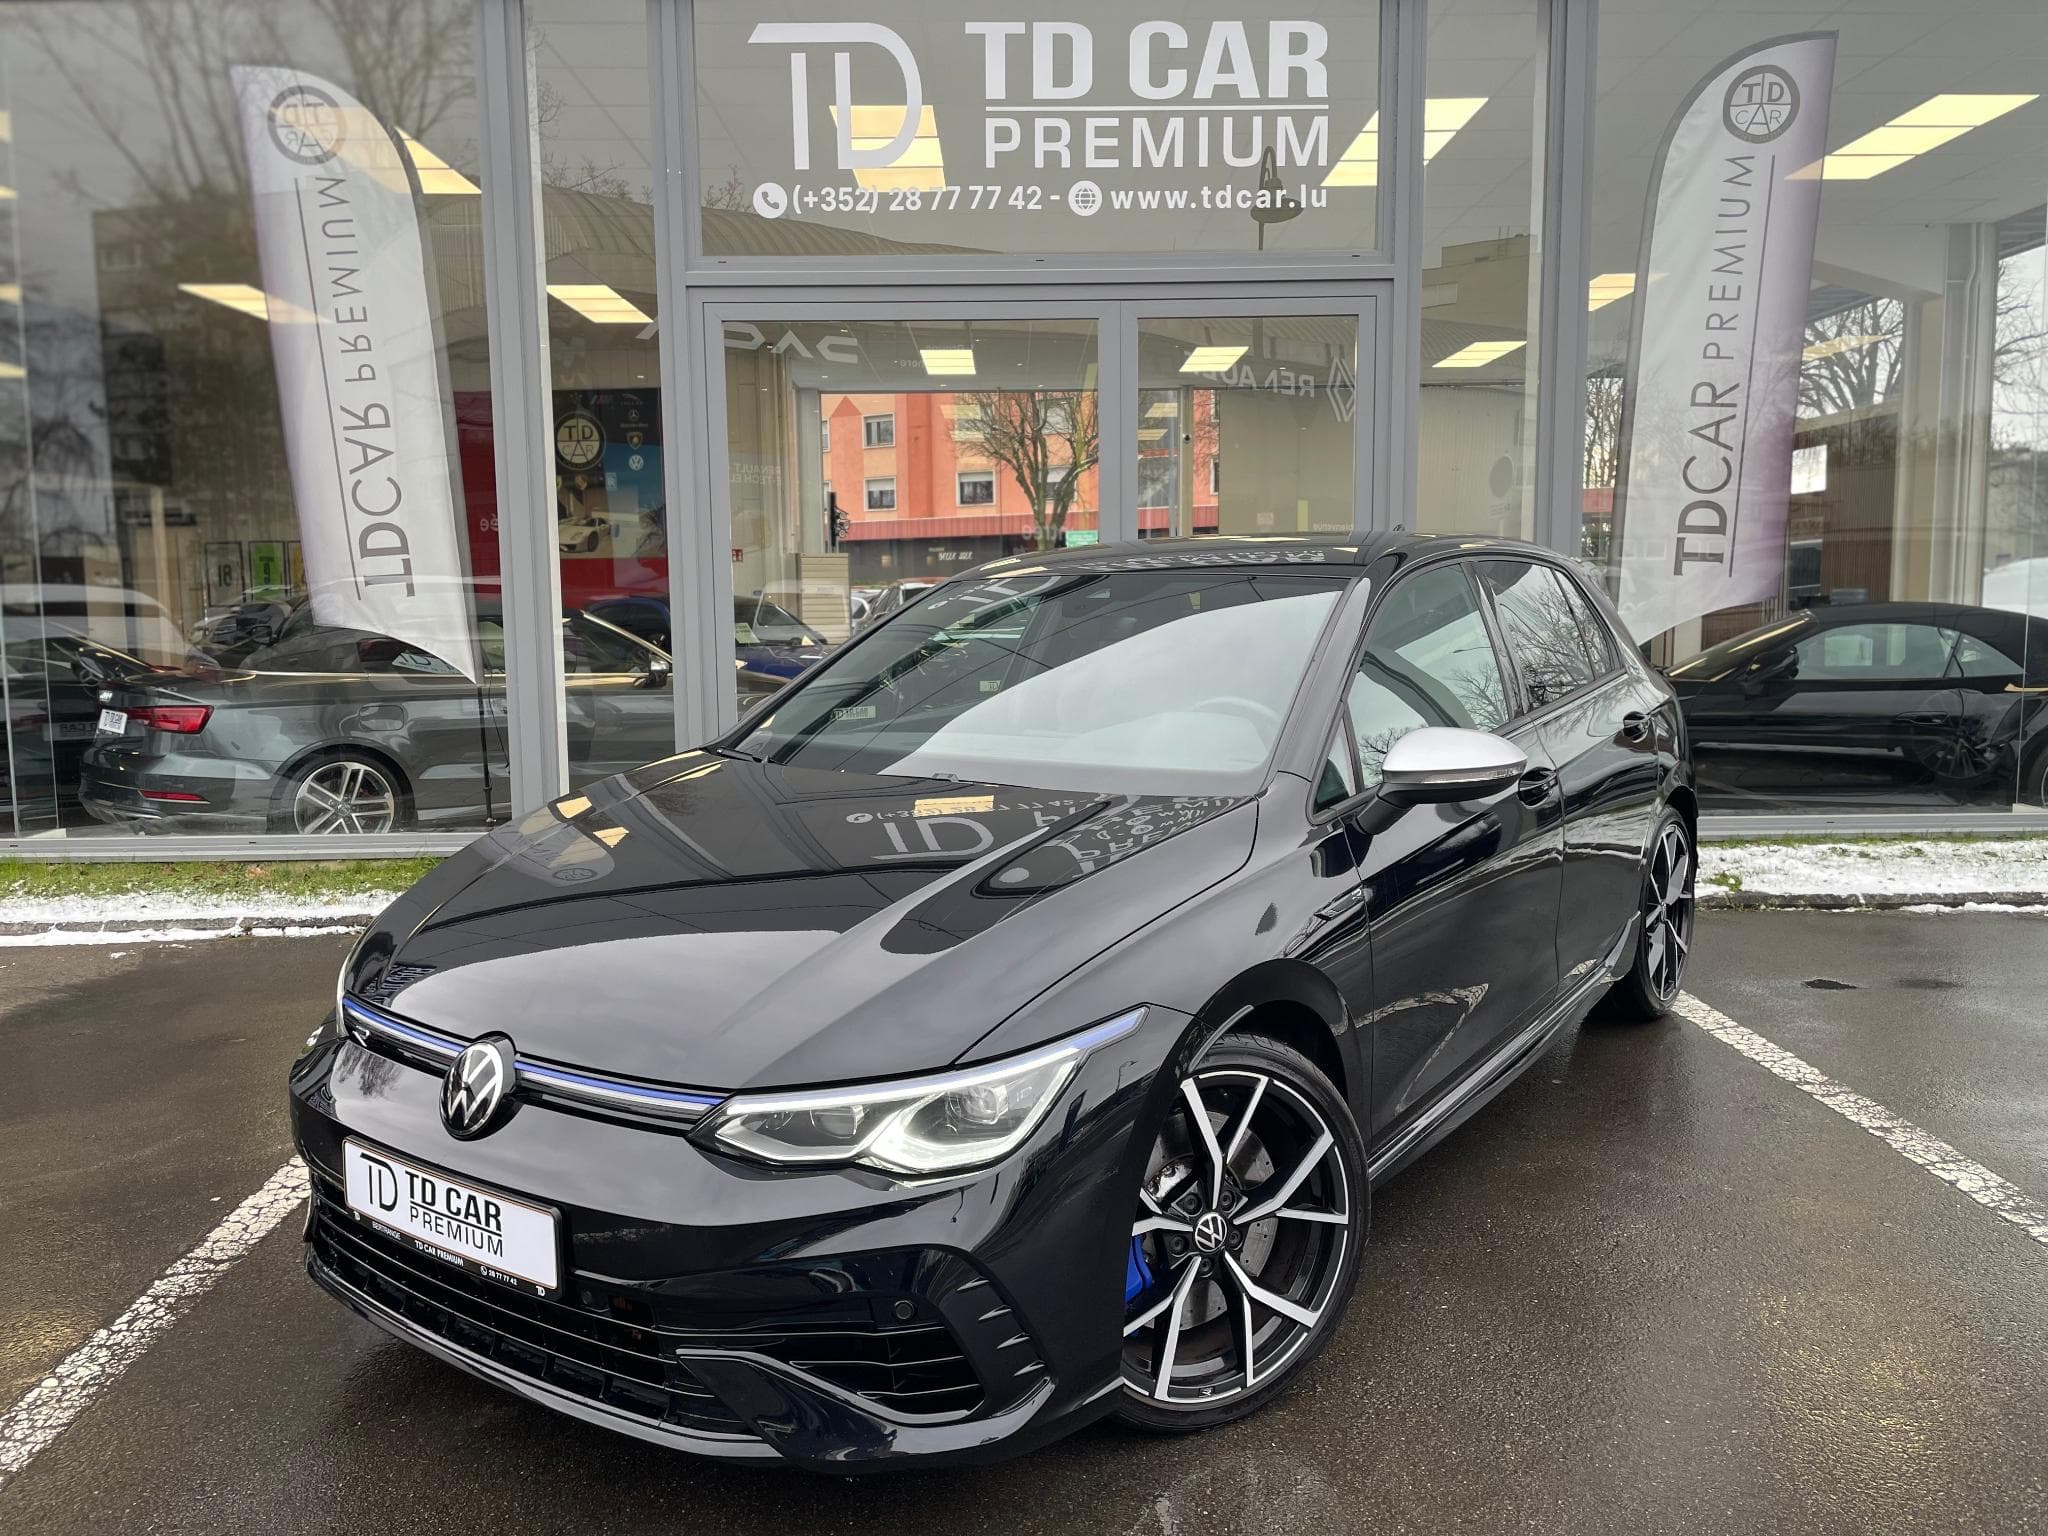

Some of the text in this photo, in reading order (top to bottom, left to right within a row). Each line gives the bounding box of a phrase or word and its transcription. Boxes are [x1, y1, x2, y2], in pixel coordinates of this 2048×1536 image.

[965, 20, 1328, 99] TD CAR
[985, 116, 1329, 168] PREMIUM
[793, 185, 879, 214] (+352)
[889, 186, 922, 211] 28
[929, 186, 961, 211] 77
[969, 185, 1002, 210] 77
[1008, 185, 1042, 210] 42
[1111, 184, 1327, 210] www.tdcar.lu
[1703, 156, 1755, 360] PREMIUM
[405, 1170, 502, 1232] TD CAR
[410, 1206, 503, 1258] PREMIUM
[414, 1240, 464, 1267] TD CAR PREMIUM
